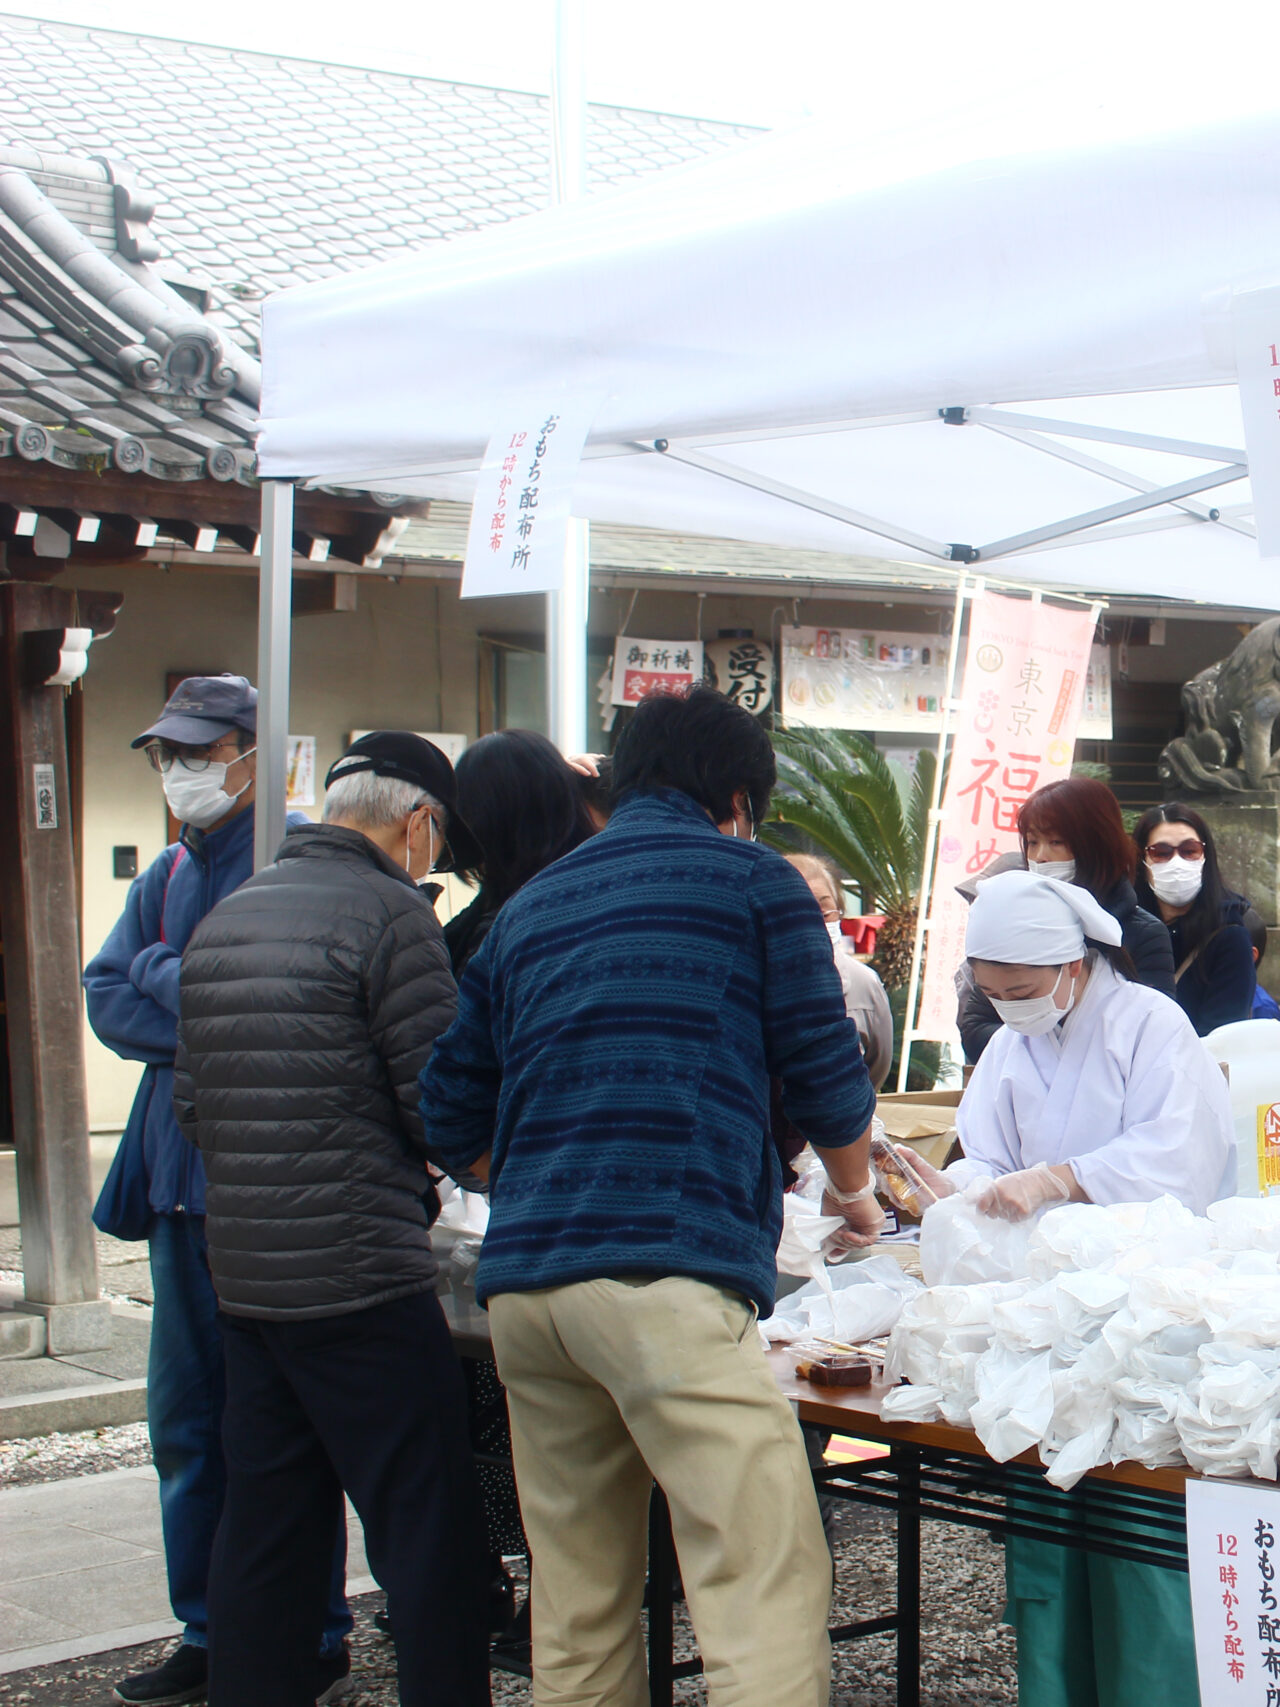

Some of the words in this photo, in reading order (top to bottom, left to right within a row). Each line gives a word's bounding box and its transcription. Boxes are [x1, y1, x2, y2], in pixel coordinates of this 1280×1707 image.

[489, 432, 528, 553] 12時から配布
[510, 415, 560, 571] おもち配布所
[728, 643, 766, 710] 受付
[1007, 658, 1044, 737] 東京
[1216, 1533, 1245, 1683] 12時から配布
